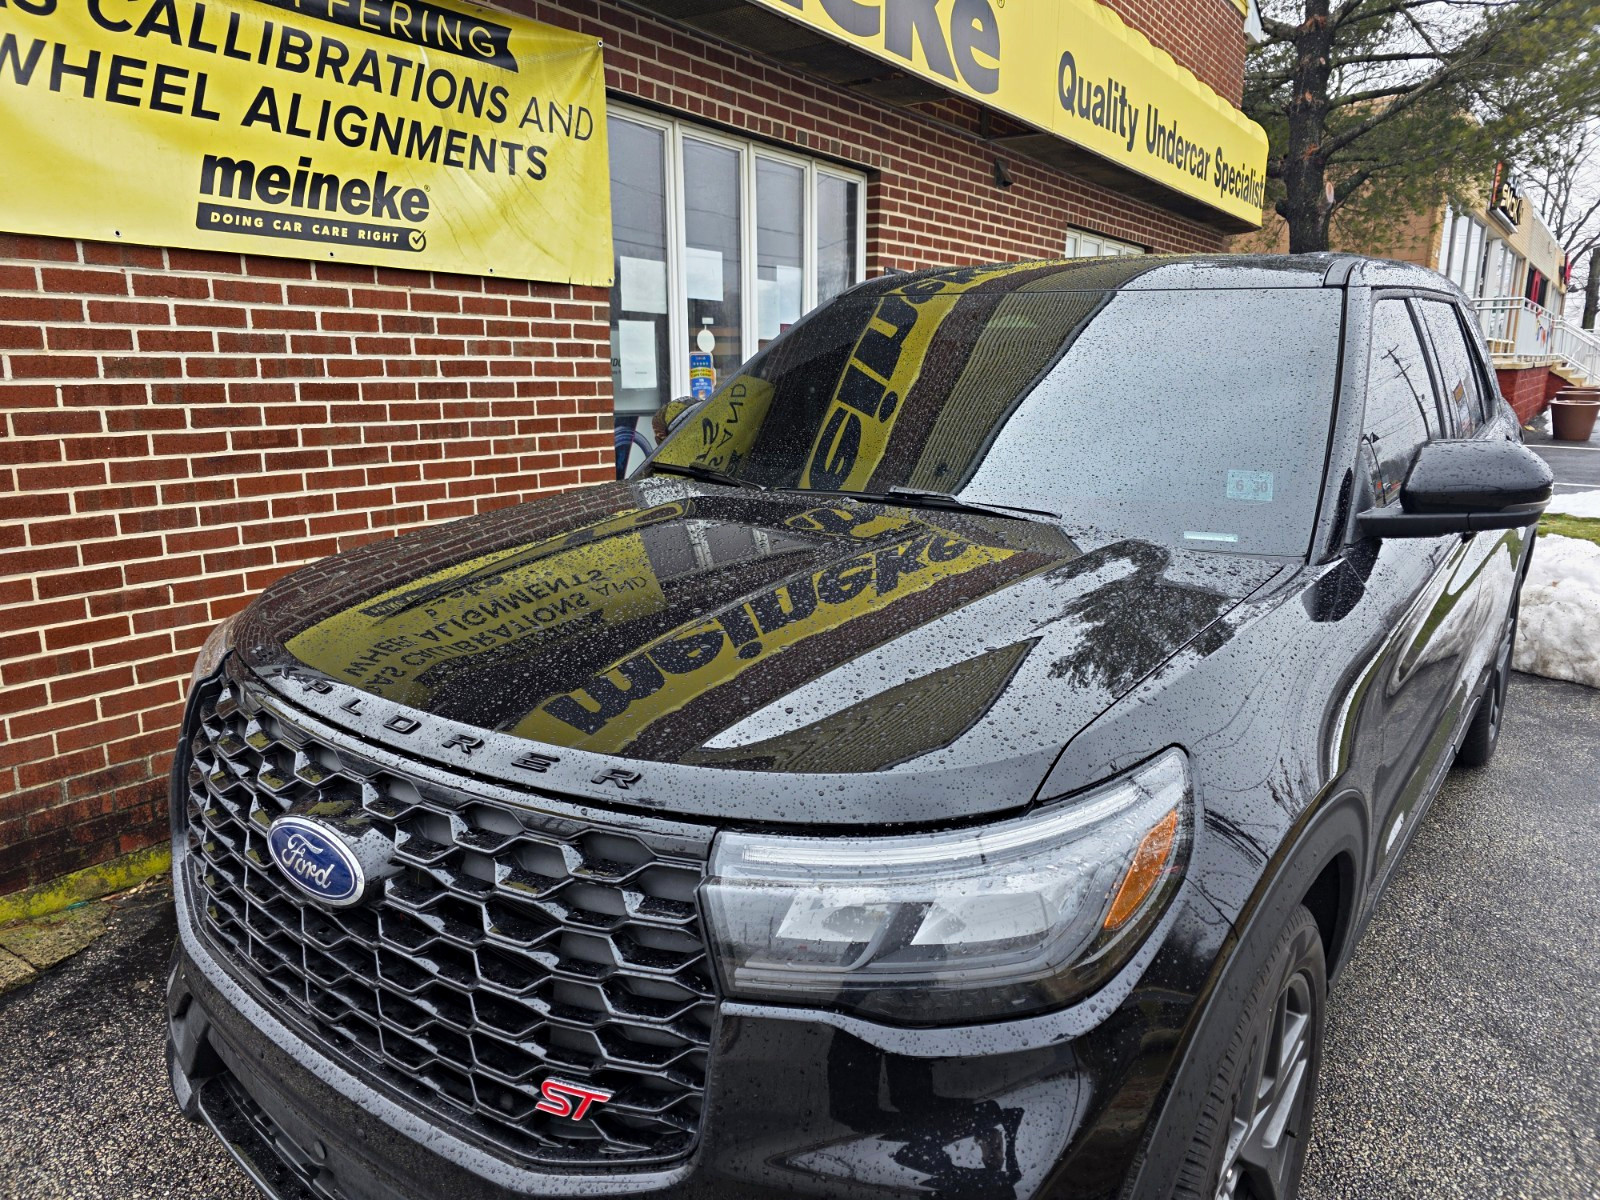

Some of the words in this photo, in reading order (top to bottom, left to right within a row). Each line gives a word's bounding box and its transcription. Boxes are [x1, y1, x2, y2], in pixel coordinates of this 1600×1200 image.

[294, 0, 496, 58] FERING
[87, 0, 509, 123] CALLIBRATIONS
[519, 96, 594, 142] AND
[241, 86, 548, 181] ALIGNMENTS
[1058, 50, 1139, 153] Quality
[1146, 103, 1211, 182] Undercar
[1214, 146, 1265, 210] Specialist
[199, 153, 430, 223] meineke
[210, 211, 264, 228] DOING
[273, 219, 302, 233] CAR
[312, 224, 348, 238] CARE
[358, 230, 399, 243] RIGHT
[282, 836, 334, 889] Ford
[535, 1077, 615, 1122] ST
